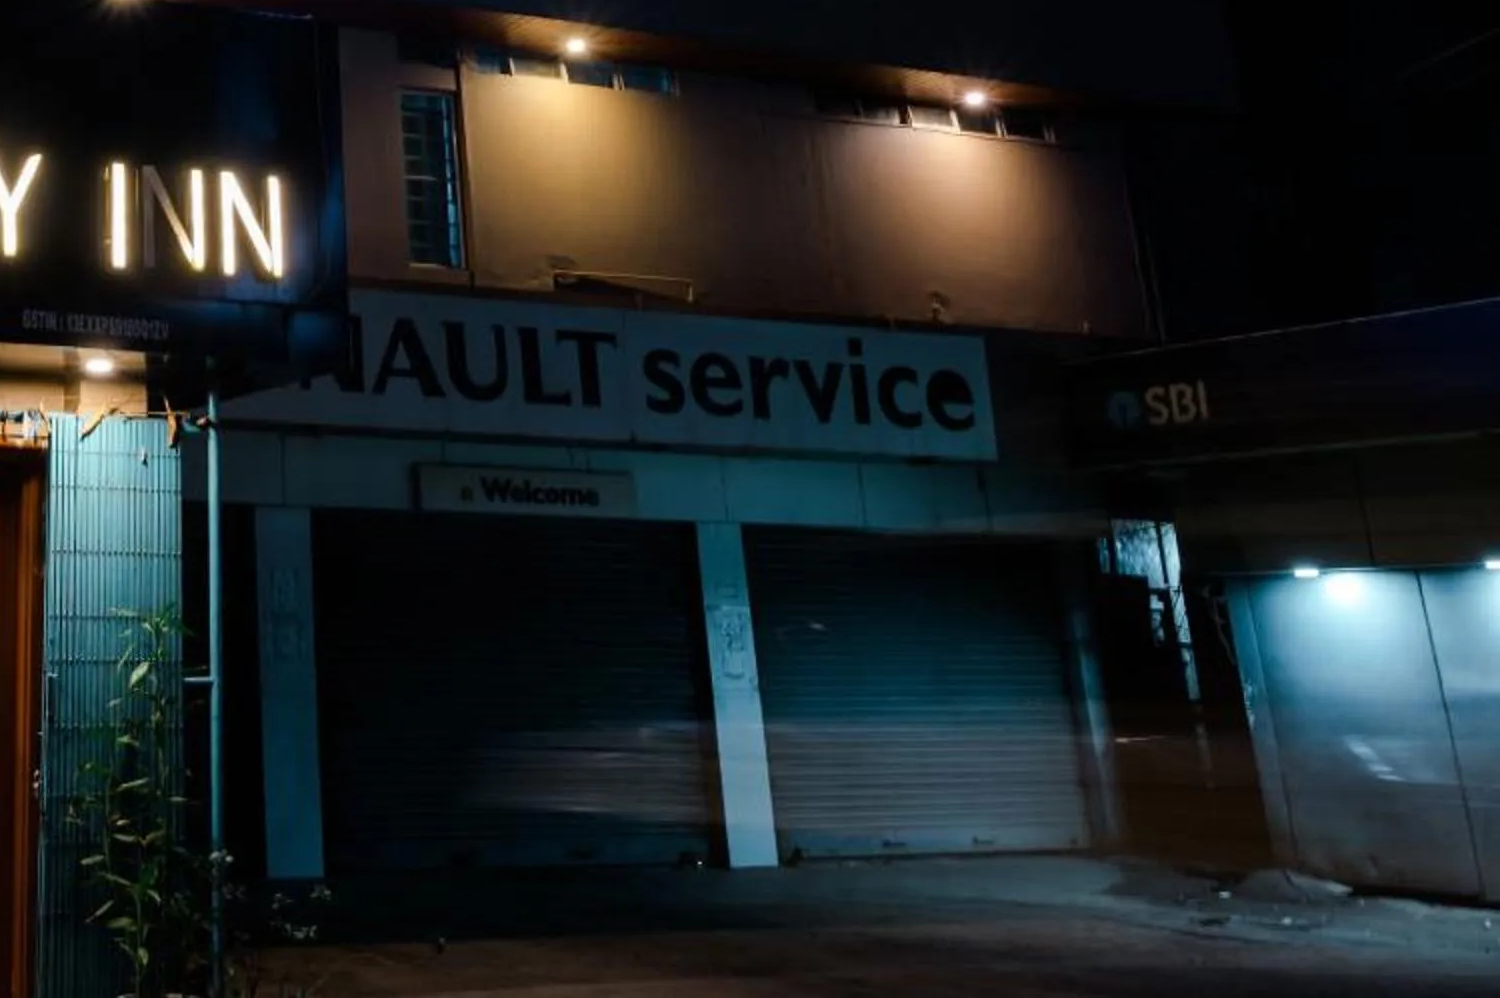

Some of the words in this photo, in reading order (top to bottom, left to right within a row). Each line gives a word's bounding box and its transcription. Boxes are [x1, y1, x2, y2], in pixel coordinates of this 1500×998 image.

[110, 161, 284, 279] INN
[643, 339, 976, 430] service
[1143, 378, 1210, 427] SBI
[480, 475, 600, 507] Welcome
